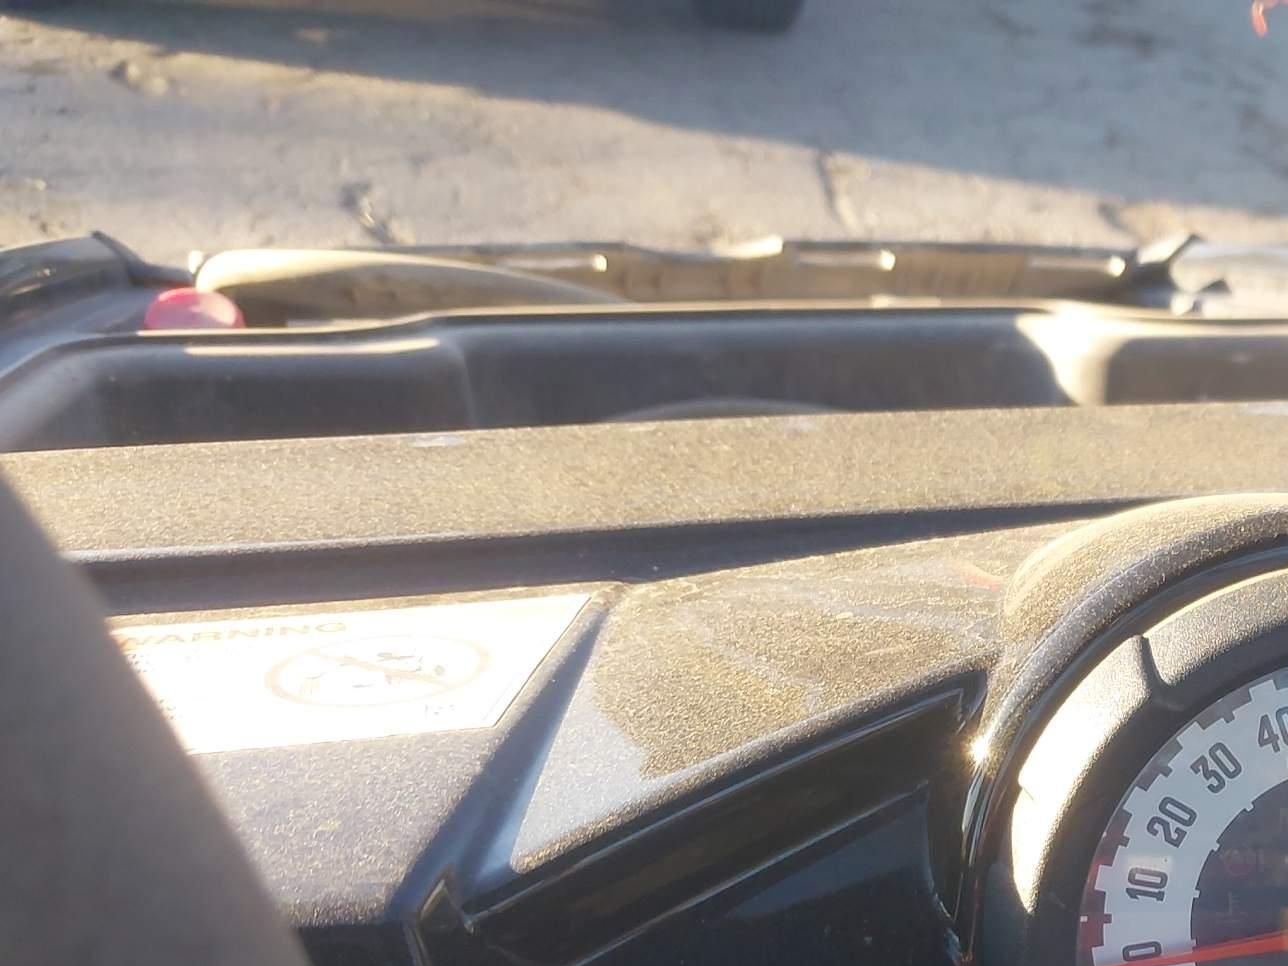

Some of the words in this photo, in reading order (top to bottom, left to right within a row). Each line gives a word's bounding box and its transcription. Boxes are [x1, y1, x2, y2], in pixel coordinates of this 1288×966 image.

[1190, 742, 1242, 793] 30
[1147, 796, 1198, 848] 20
[1125, 867, 1168, 902] 10
[1122, 941, 1162, 962] 0
